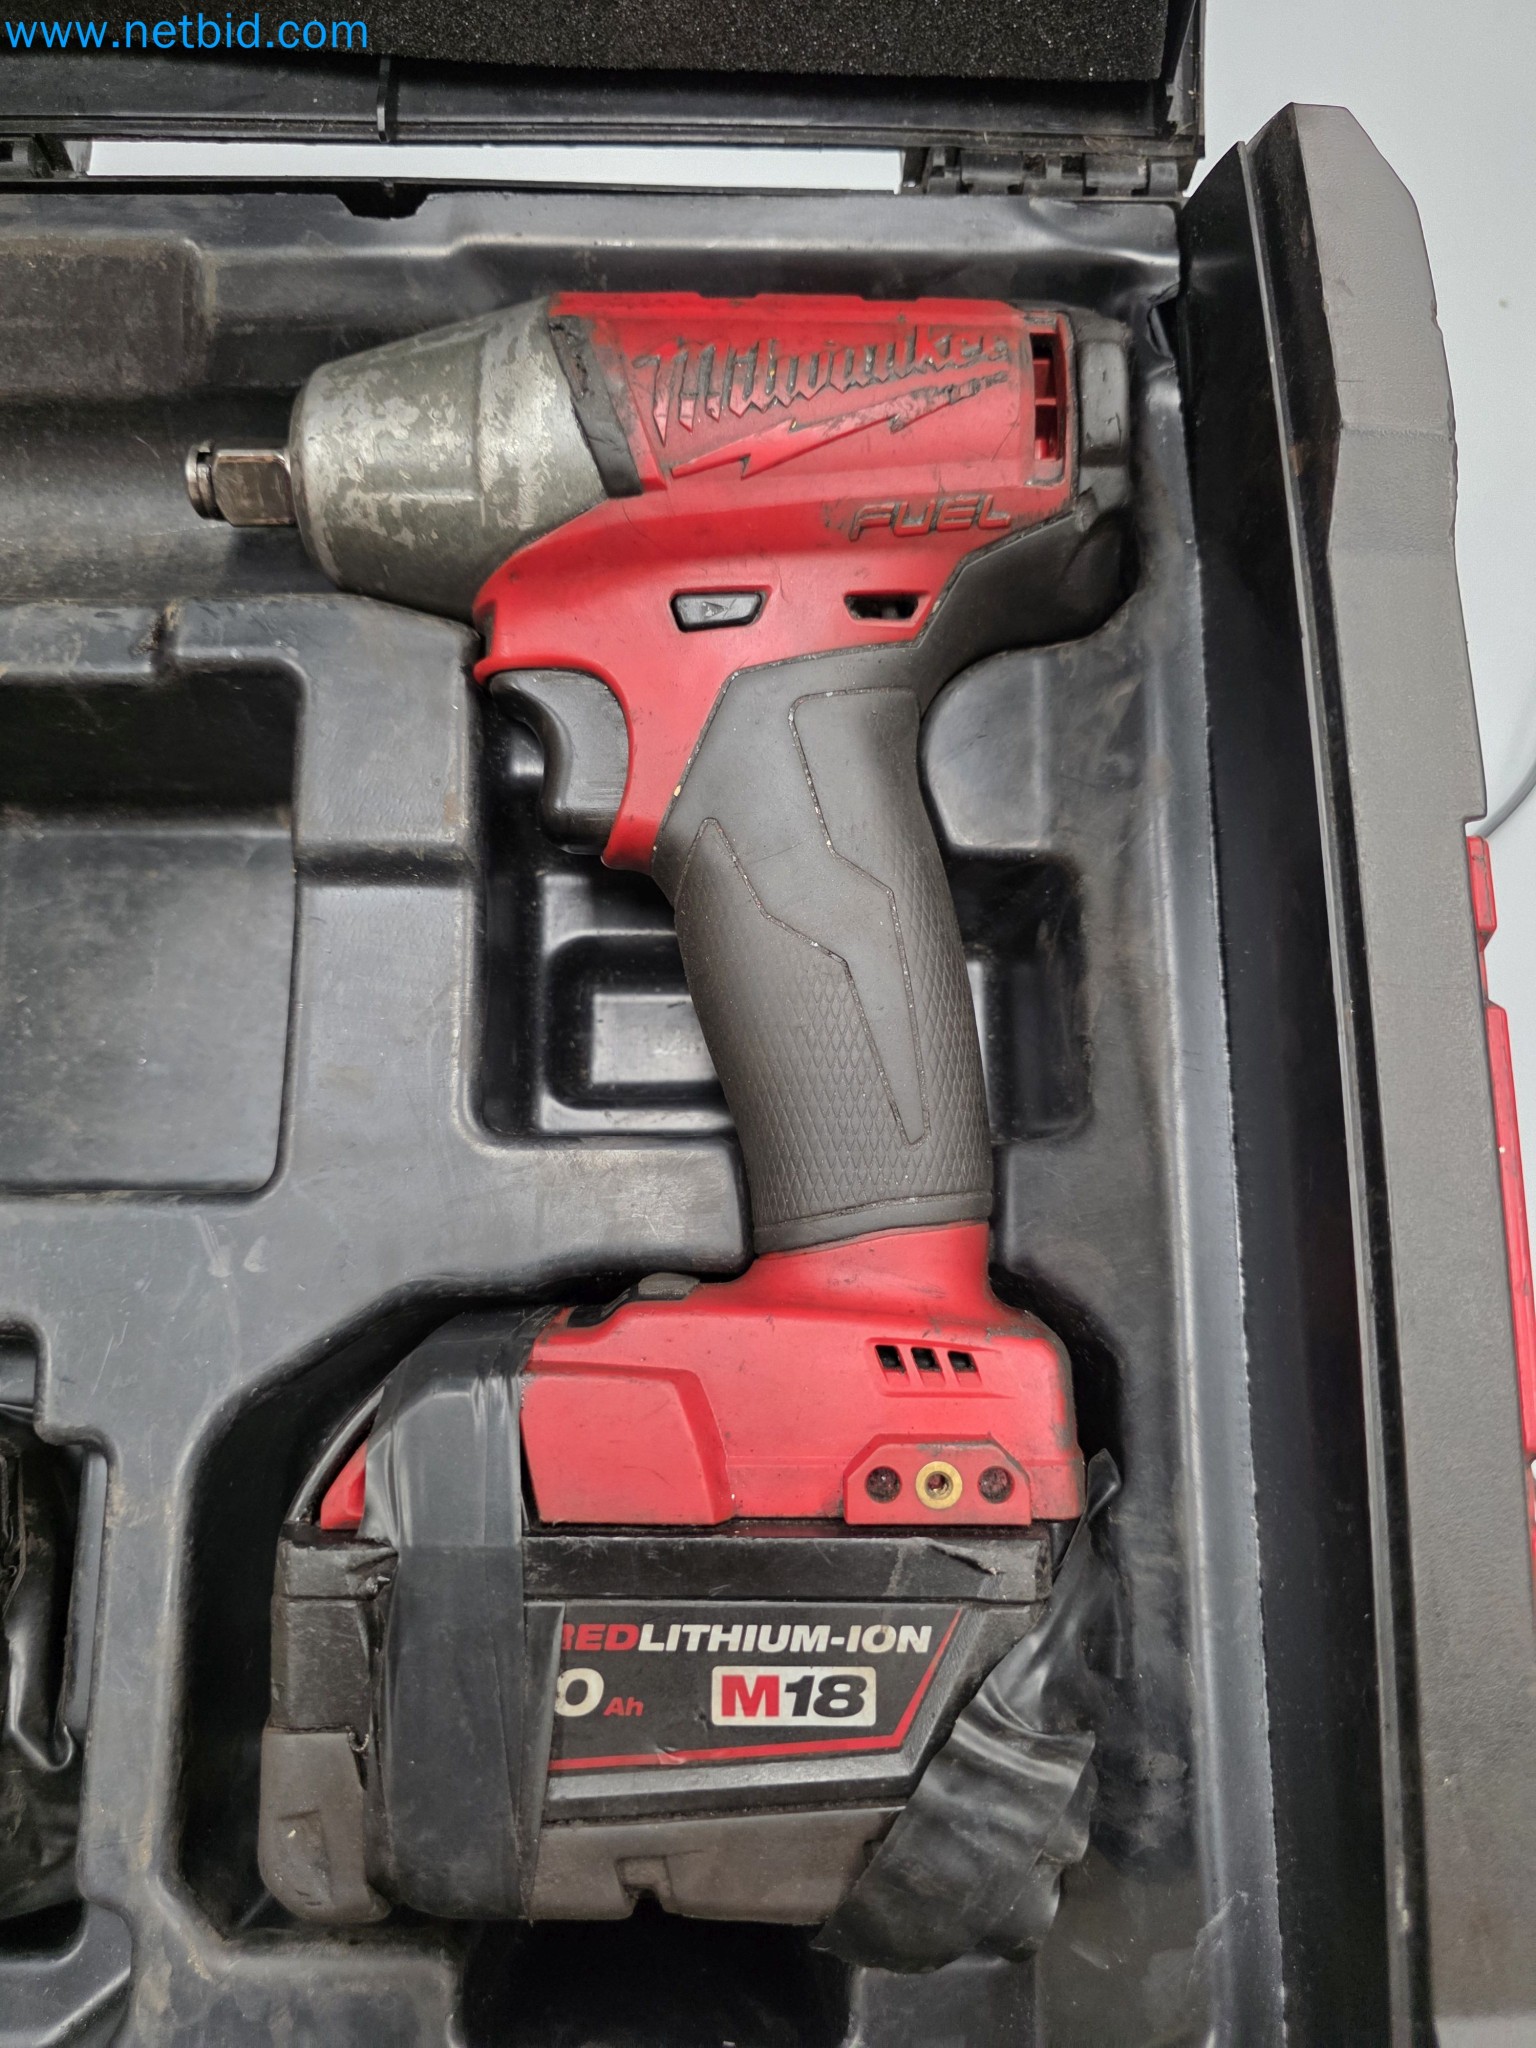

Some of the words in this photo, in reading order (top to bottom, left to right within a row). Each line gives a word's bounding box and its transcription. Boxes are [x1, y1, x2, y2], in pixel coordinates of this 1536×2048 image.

[848, 494, 1011, 541] FUEL
[603, 1696, 644, 1717] Ah
[720, 1673, 867, 1718] M18
